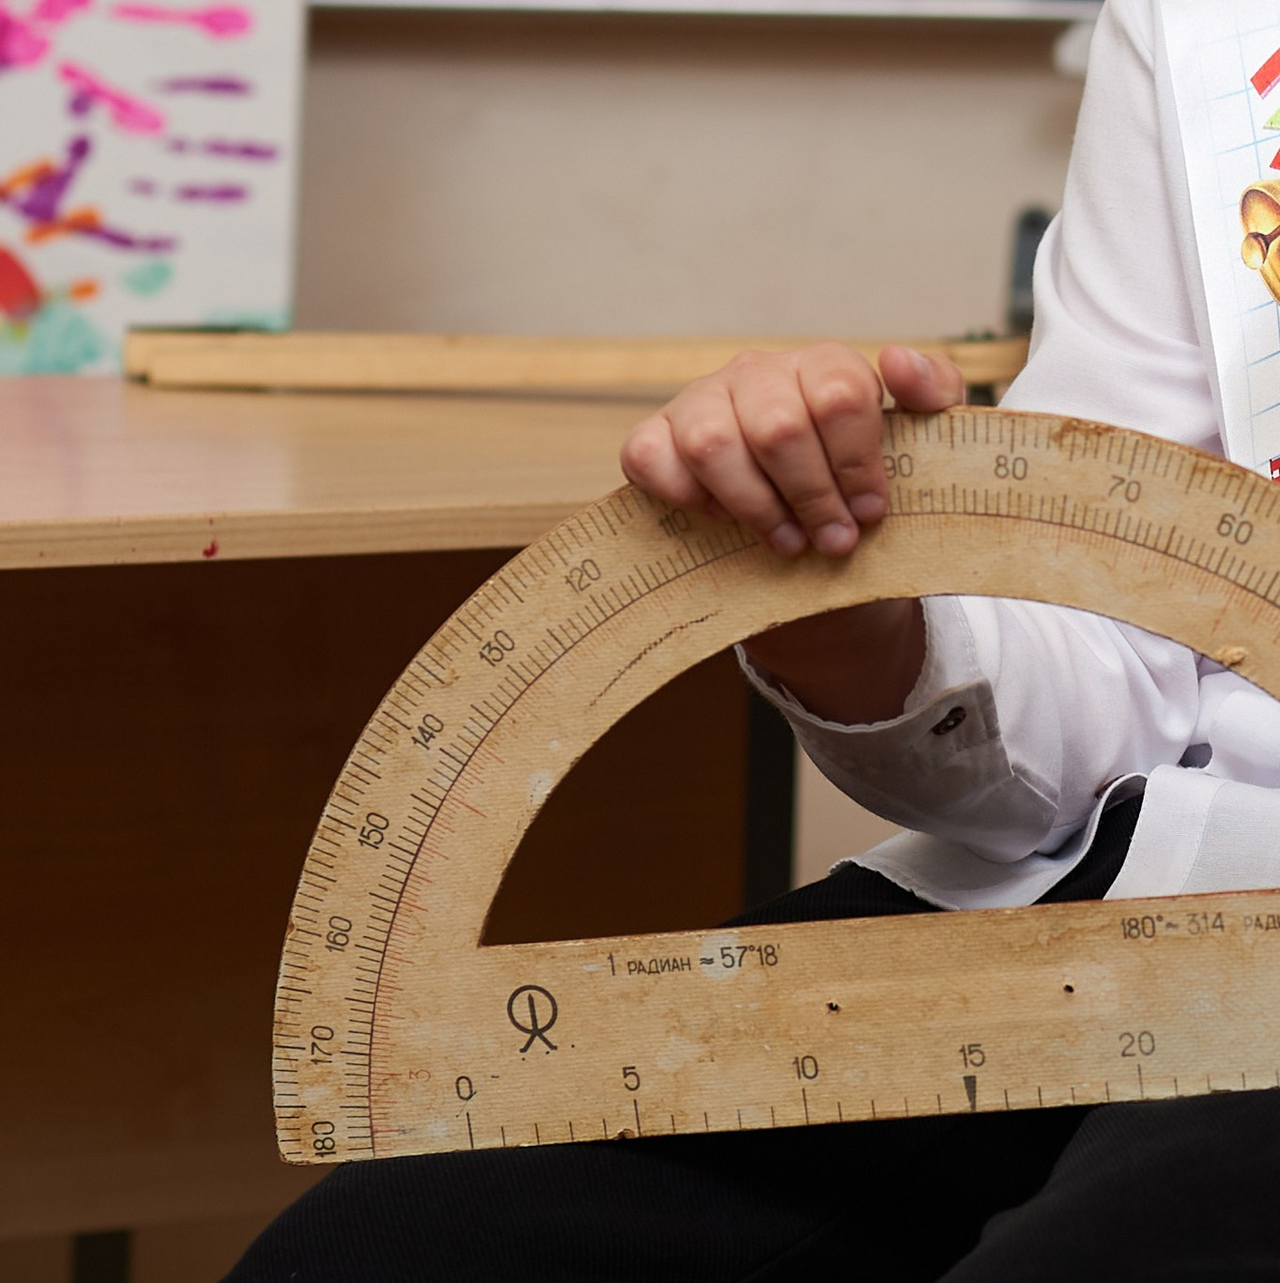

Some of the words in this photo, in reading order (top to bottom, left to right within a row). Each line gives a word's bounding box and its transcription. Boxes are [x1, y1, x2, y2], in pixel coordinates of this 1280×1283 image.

[883, 453, 914, 480] 90
[994, 455, 1028, 481] 80
[1107, 474, 1142, 503] 70
[1216, 513, 1254, 546] 60
[564, 558, 602, 594] 120
[478, 629, 516, 668] 130
[411, 713, 445, 751] 140
[357, 812, 390, 850] 150
[325, 915, 353, 953] 160
[627, 957, 692, 976] РАДИАН
[310, 1025, 334, 1065] 170
[455, 1075, 475, 1101] 0
[622, 1066, 641, 1092] 5
[792, 1055, 819, 1081] 10
[958, 1043, 986, 1069] 15
[1118, 1031, 1156, 1058] 20
[311, 1120, 337, 1158] 180
